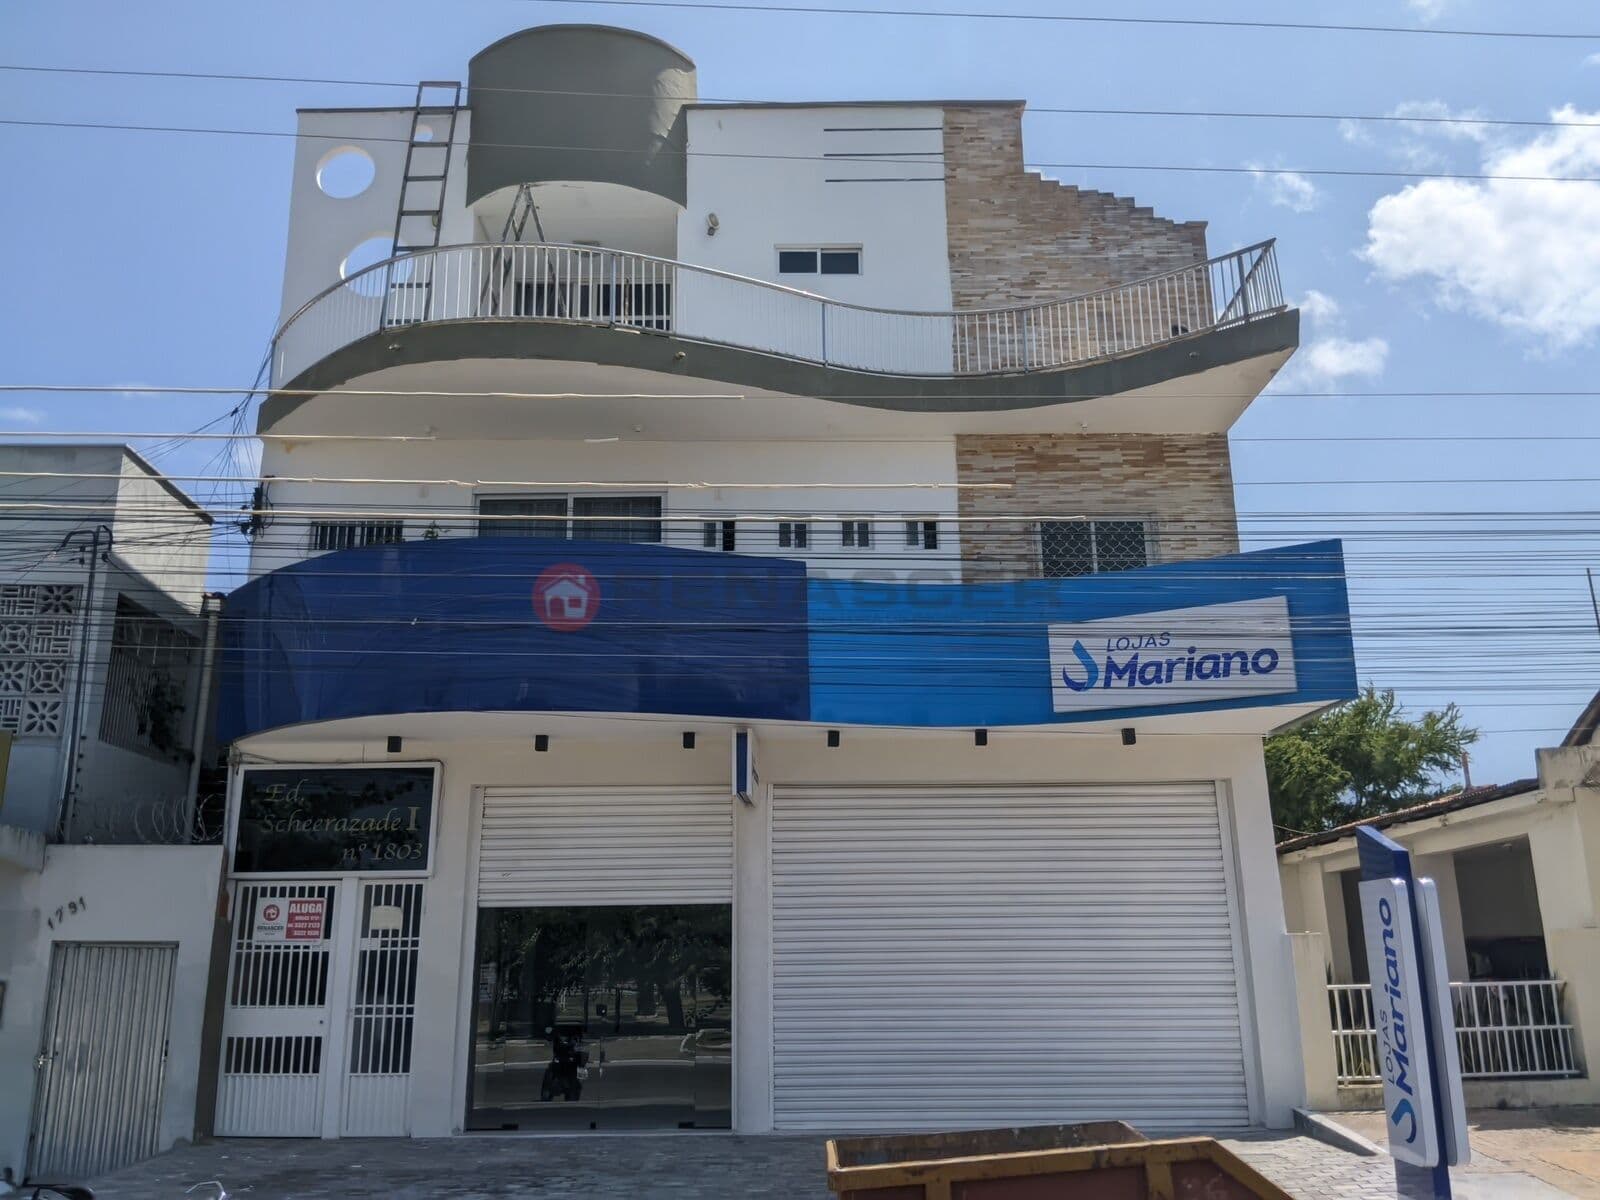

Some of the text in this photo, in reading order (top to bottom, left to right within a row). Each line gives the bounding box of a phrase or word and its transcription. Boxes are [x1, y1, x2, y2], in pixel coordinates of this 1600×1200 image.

[1106, 632, 1171, 653] LOJAS
[1103, 646, 1279, 690] Mariano
[263, 778, 309, 803] Ed.
[261, 806, 422, 836] Scheerazade I
[370, 842, 423, 861] 1803
[47, 896, 87, 931] 1791
[289, 903, 322, 913] ALUGA
[1378, 897, 1413, 1096] Mariano
[1379, 1008, 1395, 1087] LOJAS
